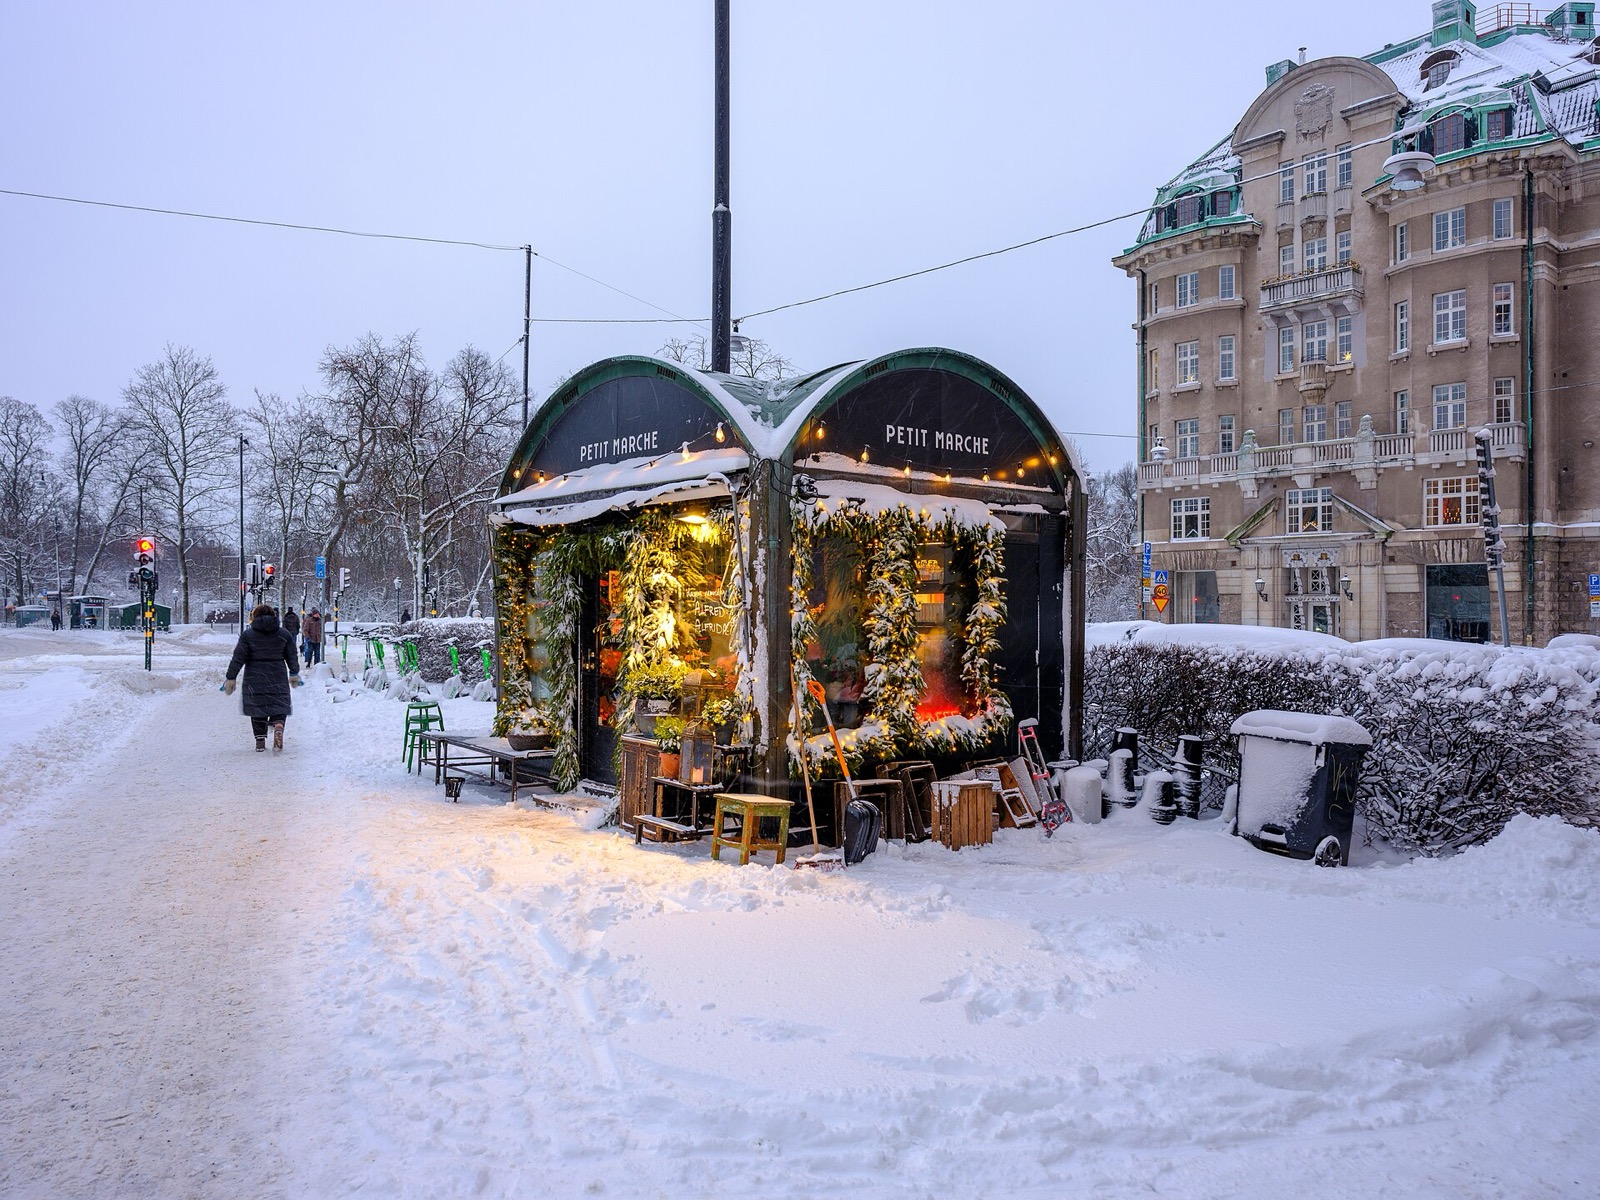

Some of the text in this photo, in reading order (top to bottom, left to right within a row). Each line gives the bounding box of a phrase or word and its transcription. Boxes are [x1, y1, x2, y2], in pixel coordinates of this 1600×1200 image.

[580, 430, 658, 462] PETIT MARCHE
[886, 424, 989, 455] PETIT MARCHE
[1592, 577, 1598, 585] P
[695, 601, 725, 617] ALFRED
